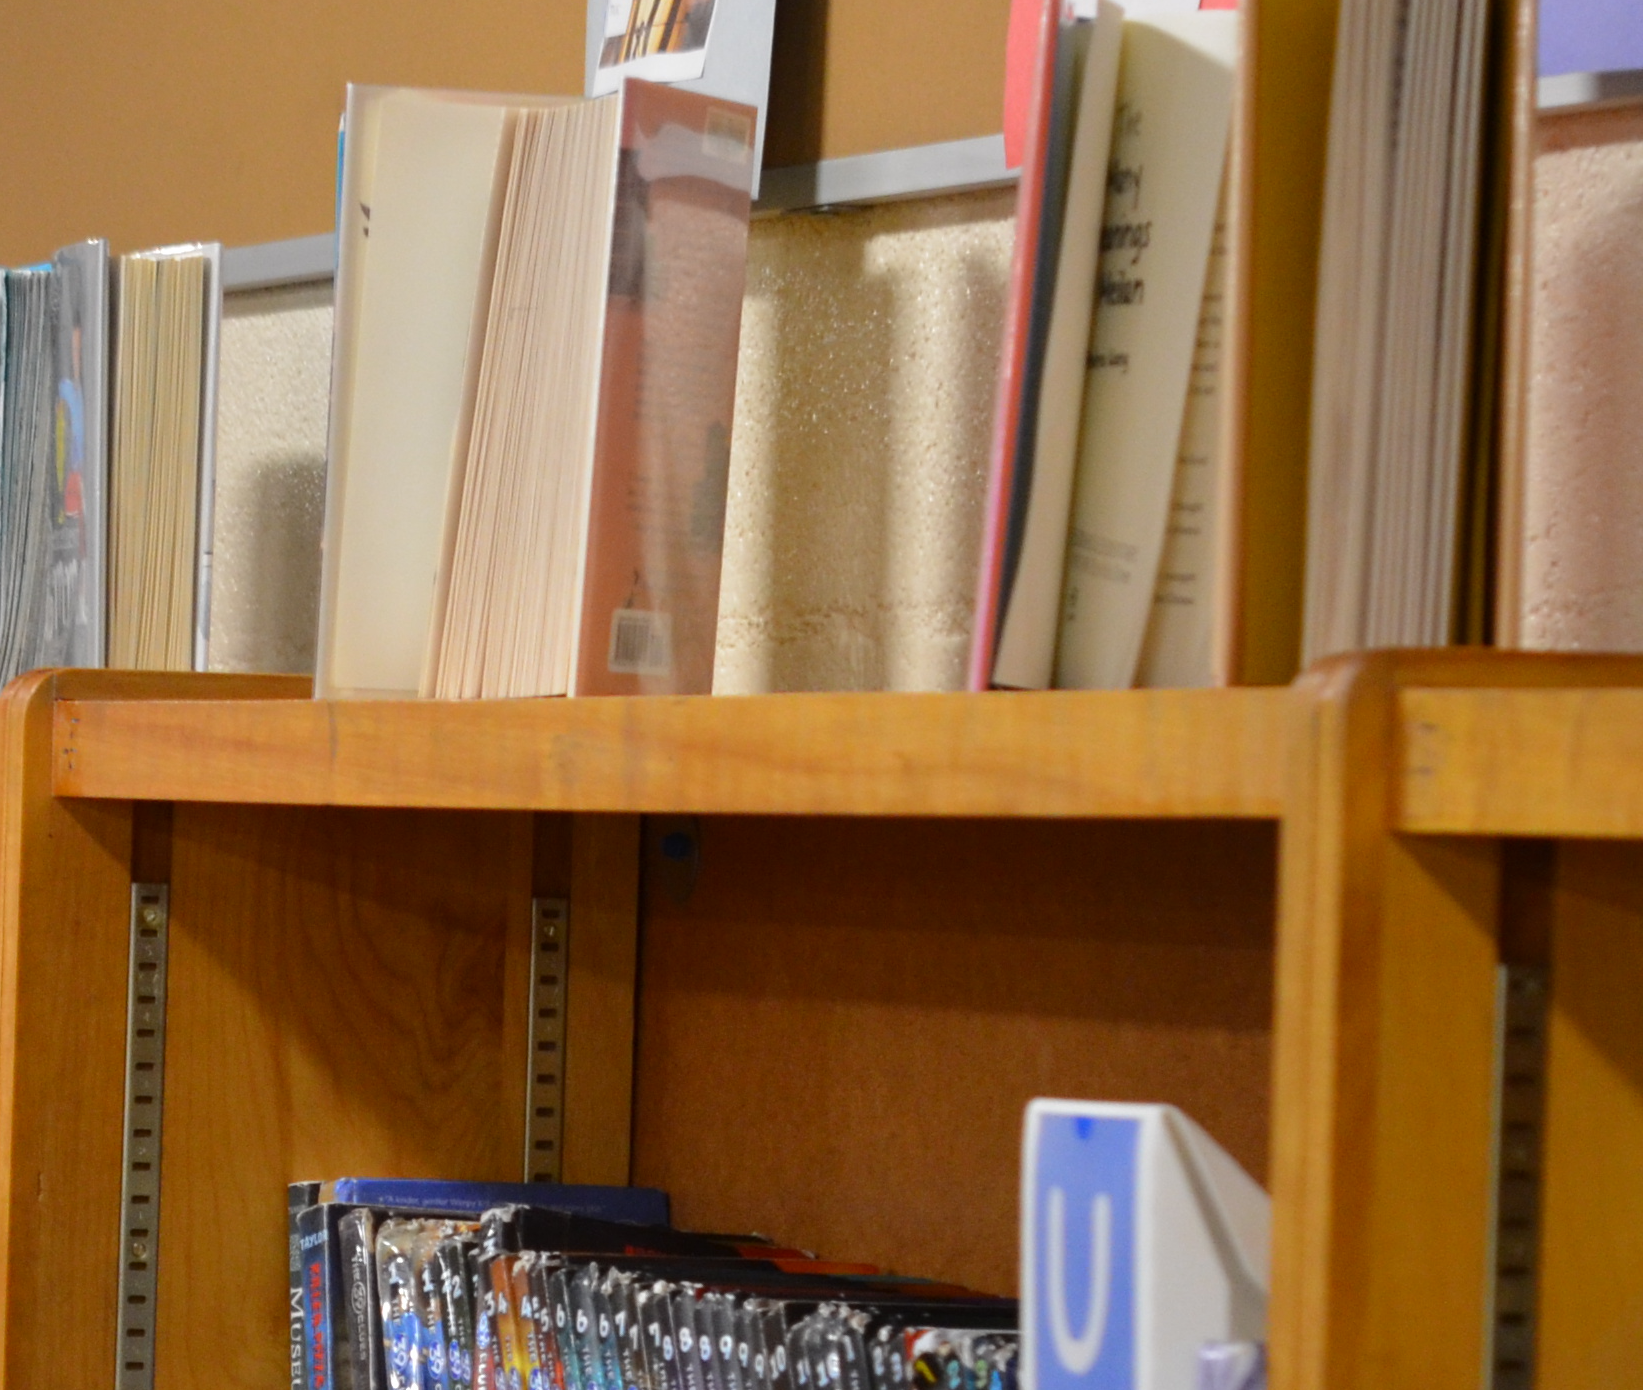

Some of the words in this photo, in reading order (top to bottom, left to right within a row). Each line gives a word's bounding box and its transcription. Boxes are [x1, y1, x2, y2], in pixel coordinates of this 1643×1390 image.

[1043, 1184, 1112, 1376] U
[556, 1303, 565, 1329] 6
[576, 1308, 588, 1334] 6
[599, 1313, 610, 1338] 6
[393, 1333, 409, 1372] 39
[662, 1335, 674, 1361] 8
[679, 1327, 693, 1353] 8
[699, 1335, 711, 1361] 8
[719, 1334, 733, 1360] 9
[429, 1341, 446, 1381] 39
[737, 1342, 749, 1368] 9
[754, 1353, 764, 1379] 9
